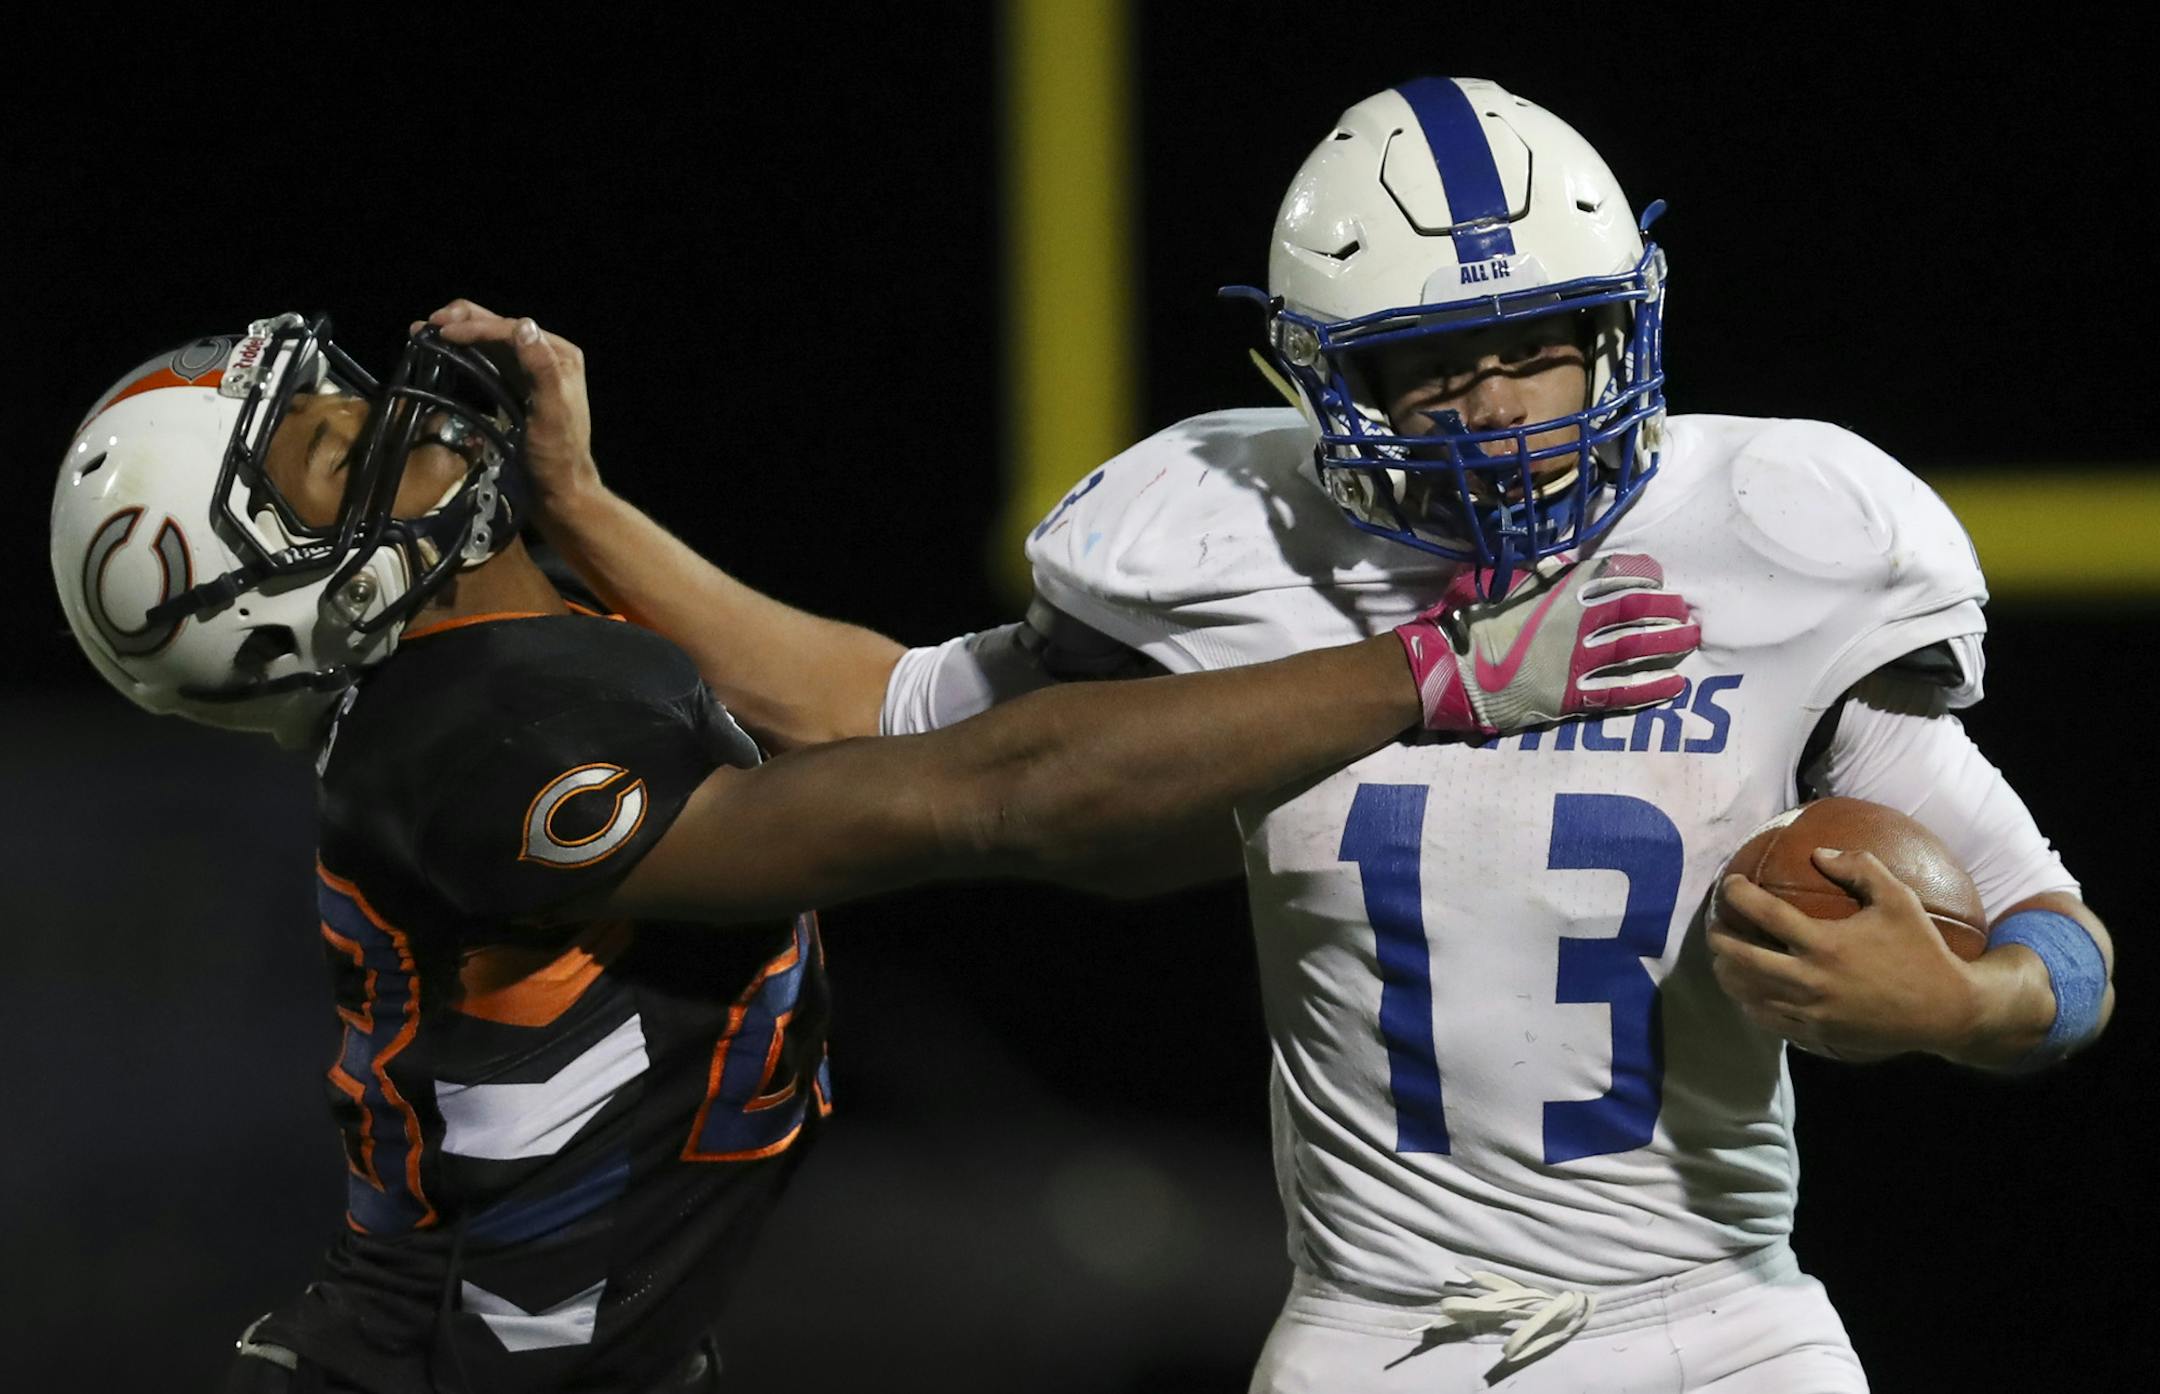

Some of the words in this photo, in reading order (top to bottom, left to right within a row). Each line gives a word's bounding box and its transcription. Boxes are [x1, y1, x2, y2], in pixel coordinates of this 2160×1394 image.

[1461, 264, 1489, 284] ALL
[1491, 260, 1511, 279] IN
[82, 504, 194, 659] C
[517, 762, 648, 869] C
[1338, 782, 1685, 1165] 13
